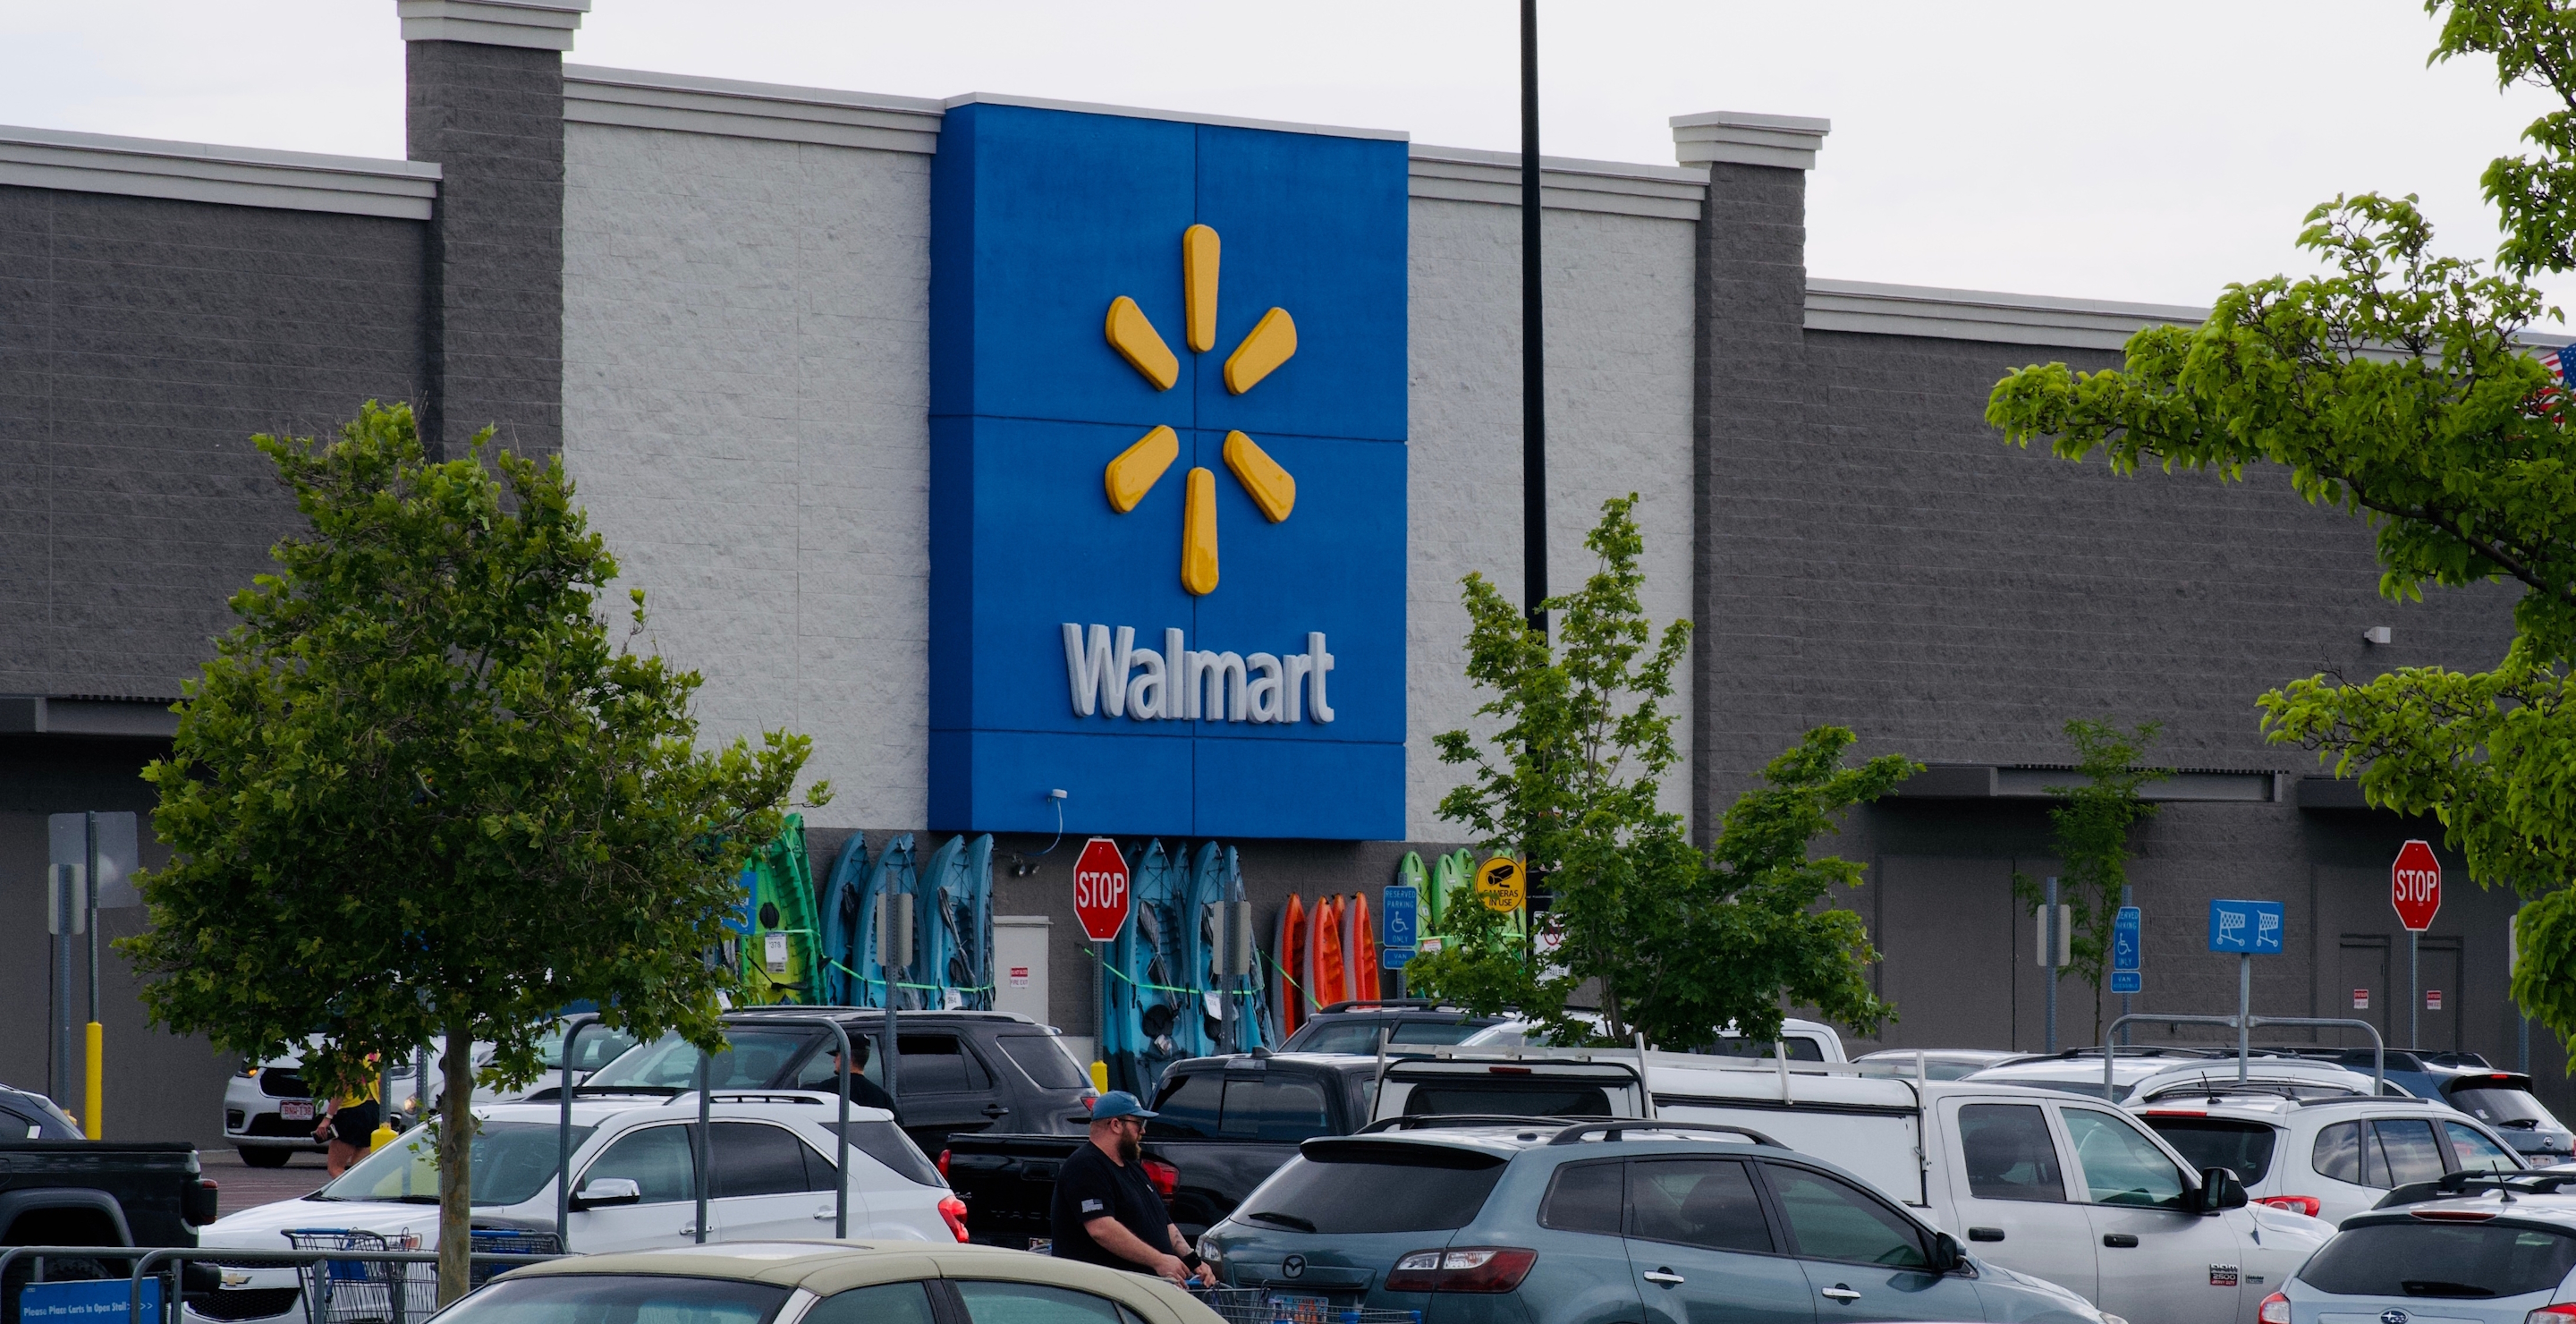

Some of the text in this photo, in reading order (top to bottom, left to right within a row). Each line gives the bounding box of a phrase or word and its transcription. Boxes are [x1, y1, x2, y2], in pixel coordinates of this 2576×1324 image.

[1062, 623, 1335, 724] Walmart
[1078, 870, 1125, 909] STOP
[2396, 869, 2437, 903] STOP
[1385, 890, 1416, 899] RESERVED
[1386, 900, 1414, 909] PARKING
[1488, 898, 1513, 906] IN USE
[1392, 935, 1409, 944] ONLY
[23, 1301, 127, 1316] Please Place Carts In Open Stall
